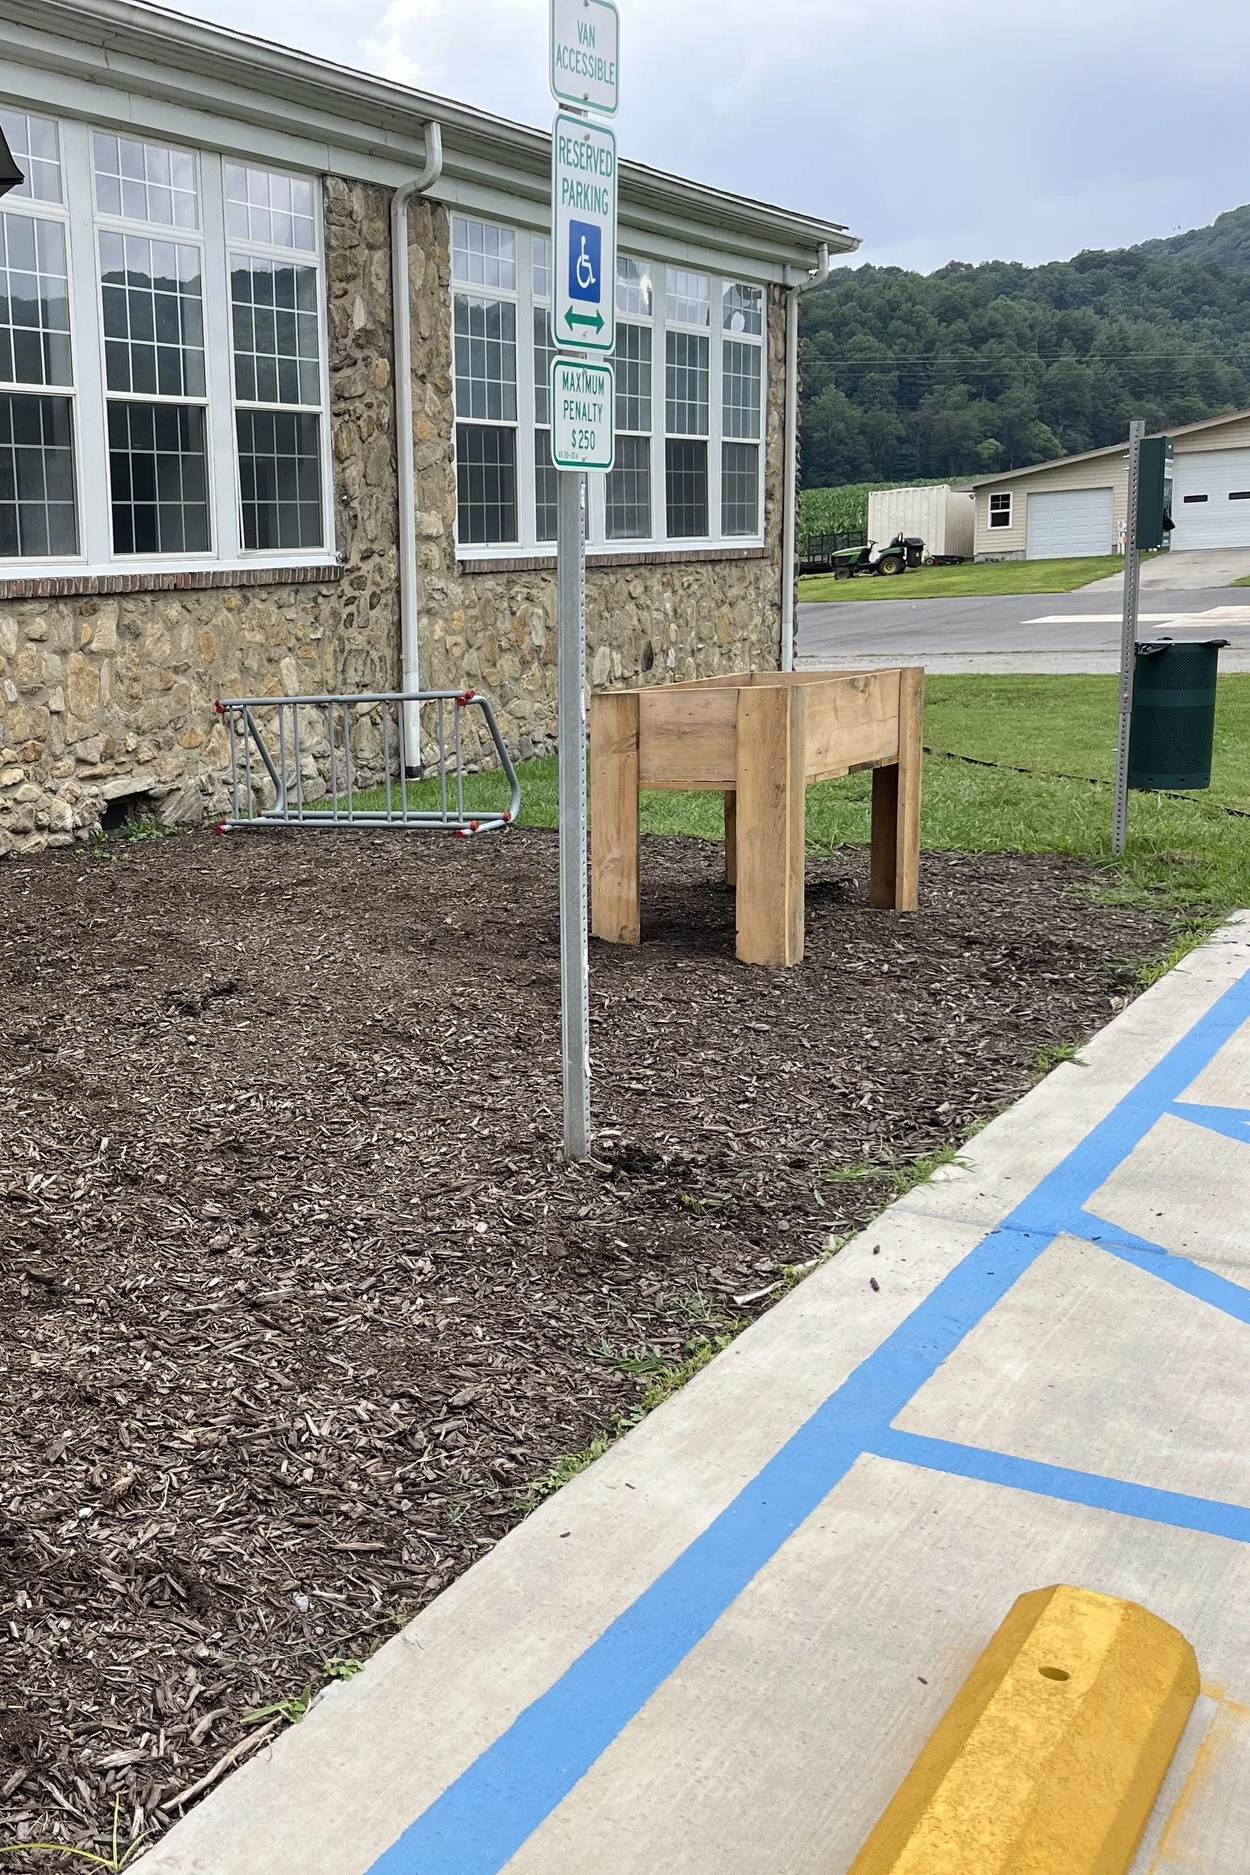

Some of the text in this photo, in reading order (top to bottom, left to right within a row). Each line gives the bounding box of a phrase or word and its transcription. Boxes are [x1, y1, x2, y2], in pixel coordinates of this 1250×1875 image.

[577, 20, 596, 49] VAN
[556, 44, 615, 85] ACCESSIBLE
[558, 135, 613, 178] RESERVED
[562, 177, 609, 216] PARKING
[562, 371, 605, 396] MAXIMUM
[563, 399, 603, 423] PENALTY
[571, 429, 596, 451] $250
